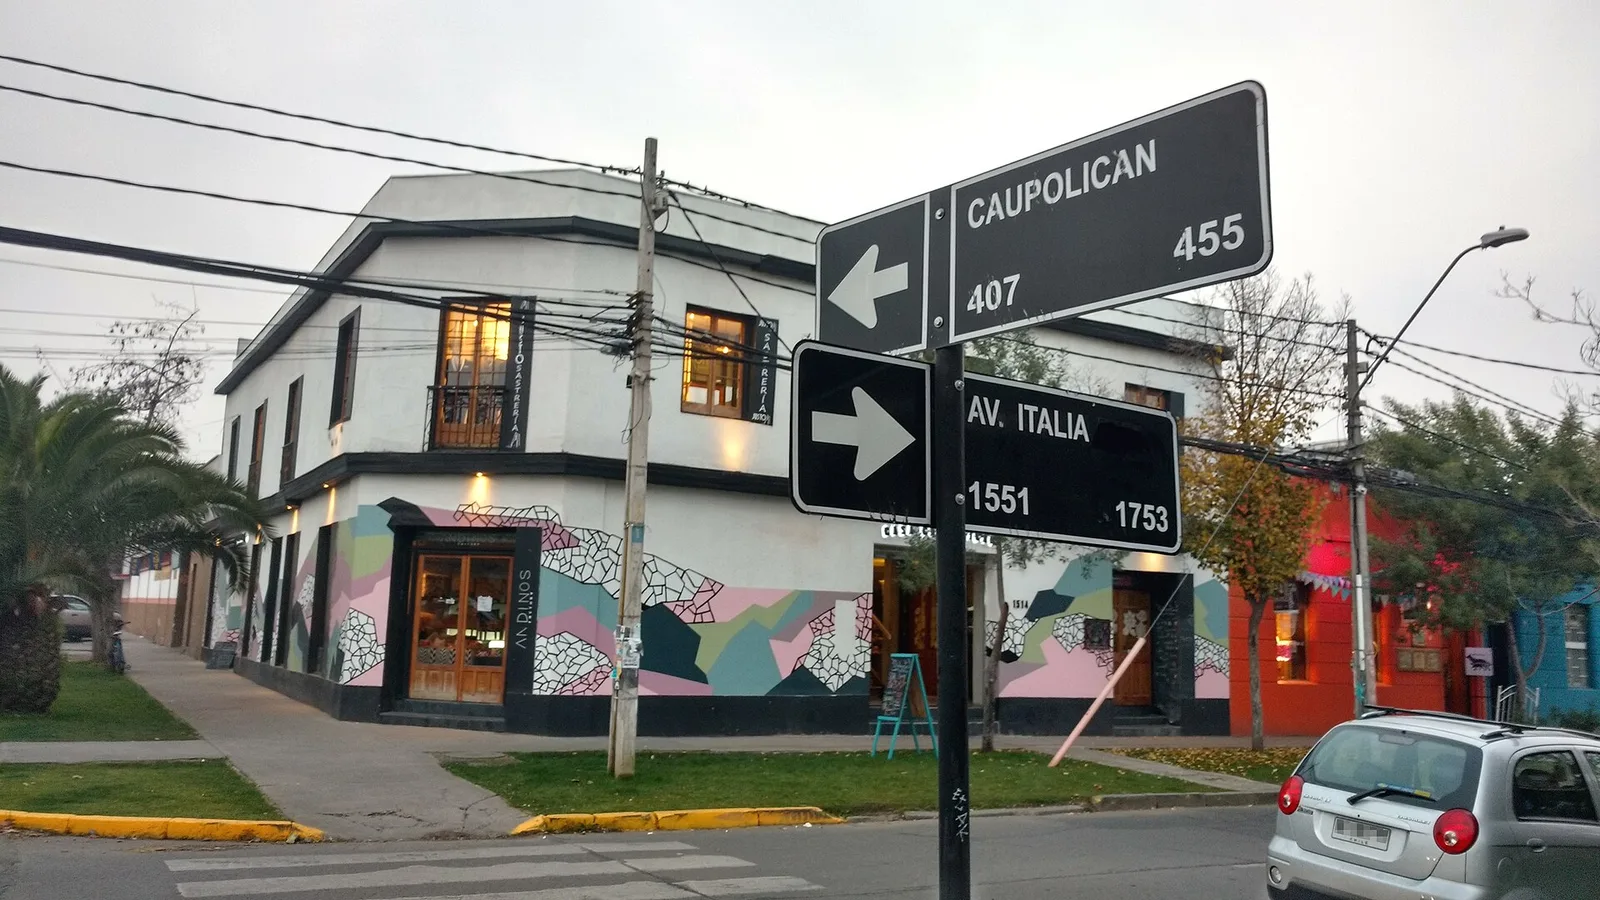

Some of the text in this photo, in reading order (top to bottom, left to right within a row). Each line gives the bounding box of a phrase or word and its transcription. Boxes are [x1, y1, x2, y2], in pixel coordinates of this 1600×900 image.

[967, 139, 1157, 229] CAUPOLICAN
[1173, 213, 1245, 261] 455
[966, 274, 1021, 314] 407
[758, 333, 771, 413] SARERIA
[967, 395, 1090, 442] AV. ITALIA
[968, 481, 1029, 515] 1551
[1115, 501, 1169, 532] 1753
[515, 569, 532, 649] ANDINOS
[1012, 599, 1029, 609] 1514
